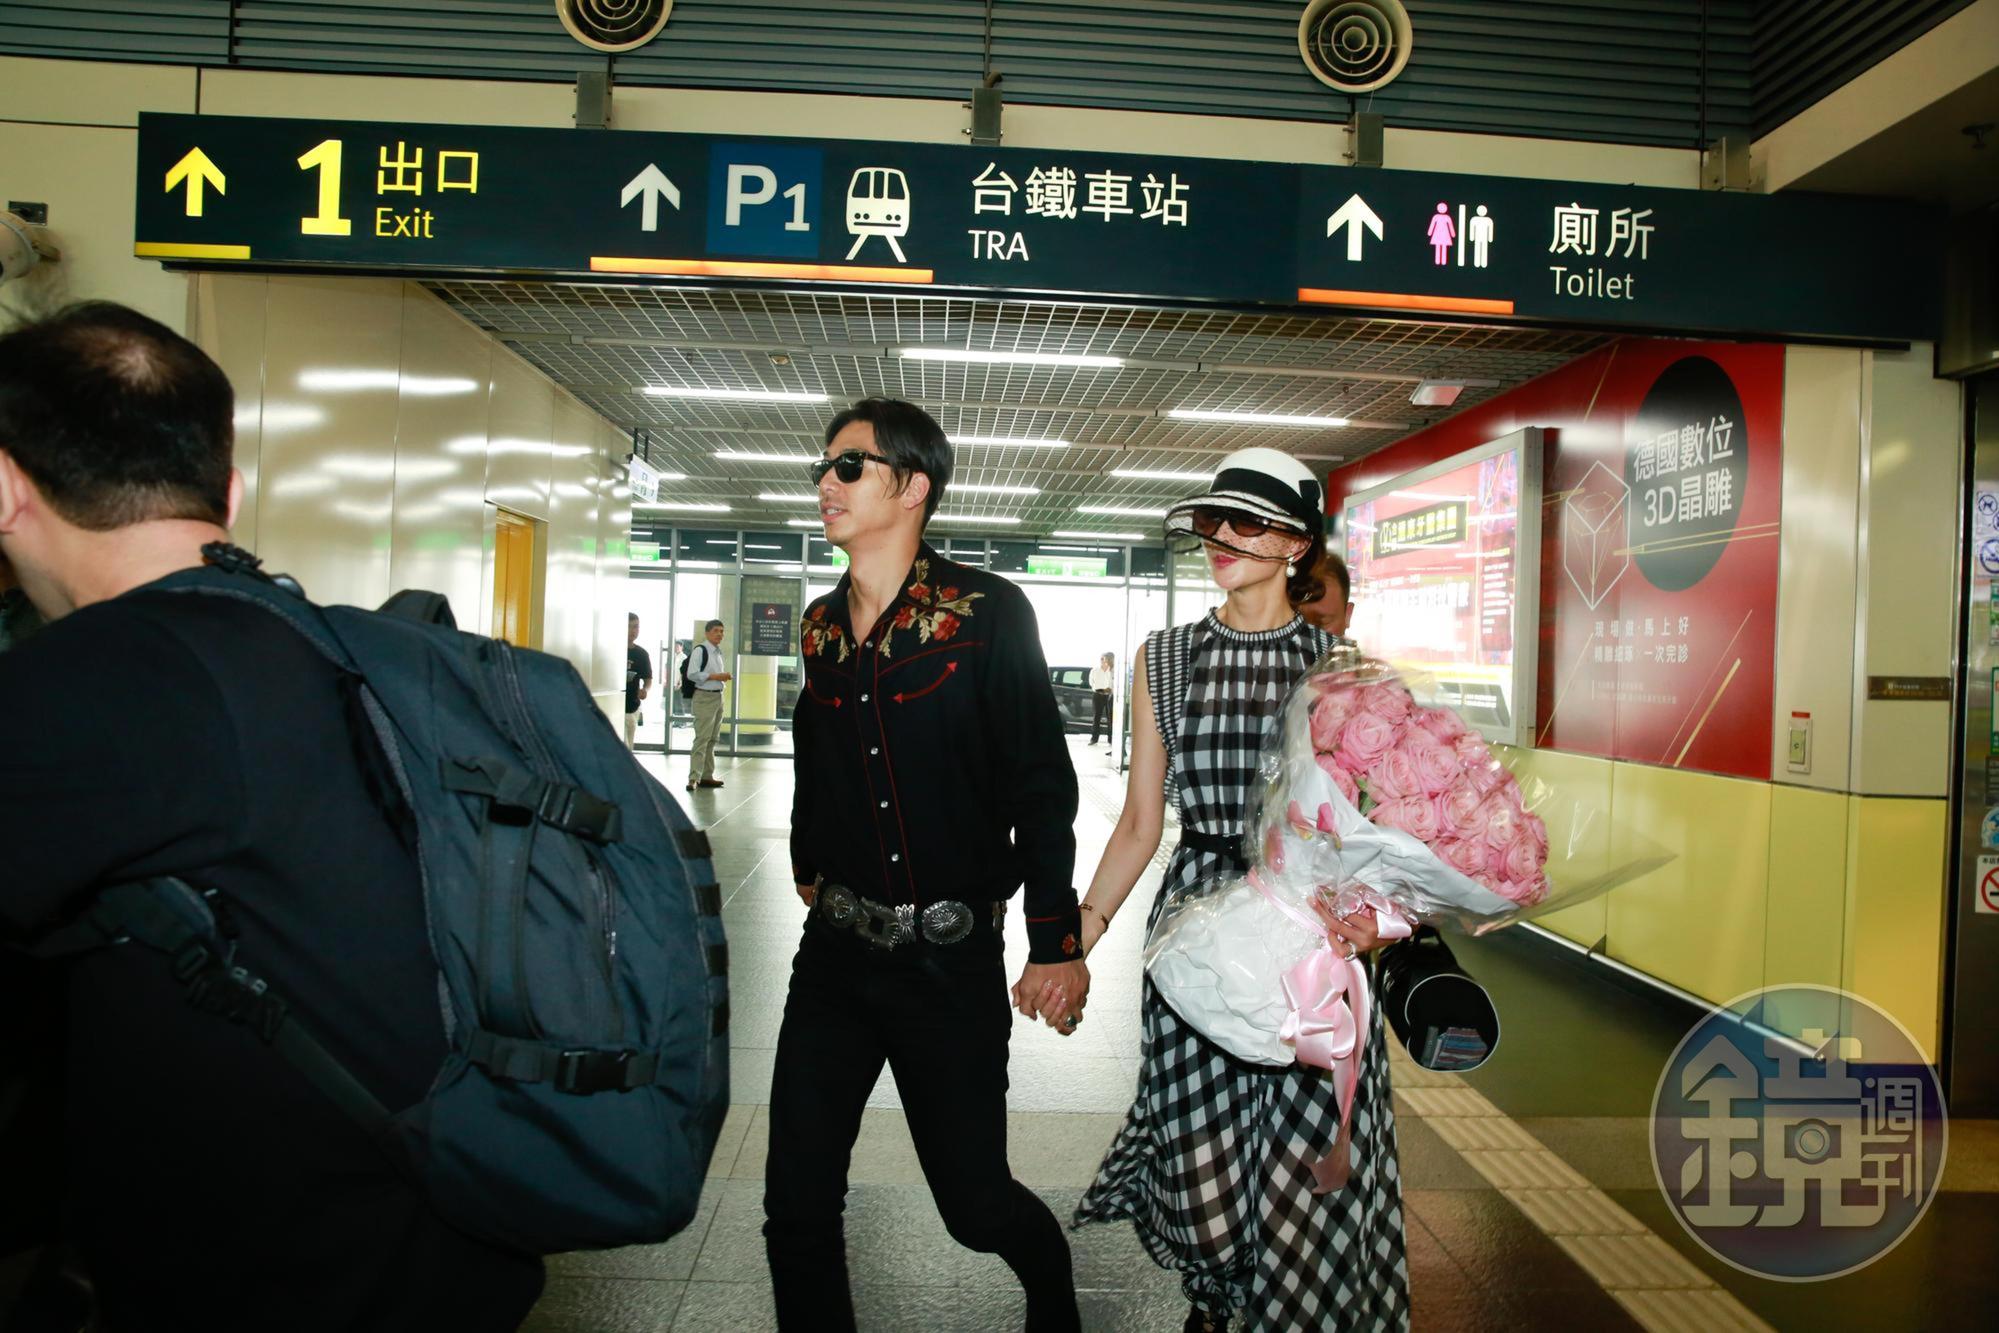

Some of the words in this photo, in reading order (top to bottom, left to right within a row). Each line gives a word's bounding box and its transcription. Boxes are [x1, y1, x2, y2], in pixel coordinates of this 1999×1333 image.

[297, 139, 353, 237] 1
[377, 141, 480, 197] 出口
[970, 161, 1191, 227] 台鐵車站
[375, 208, 435, 240] Exit
[968, 229, 1030, 262] TRA
[1548, 202, 1656, 261] 廁所
[1549, 266, 1635, 300] Toilet
[1633, 414, 1734, 483] 德國數位
[1643, 466, 1732, 527] 3D晶雕
